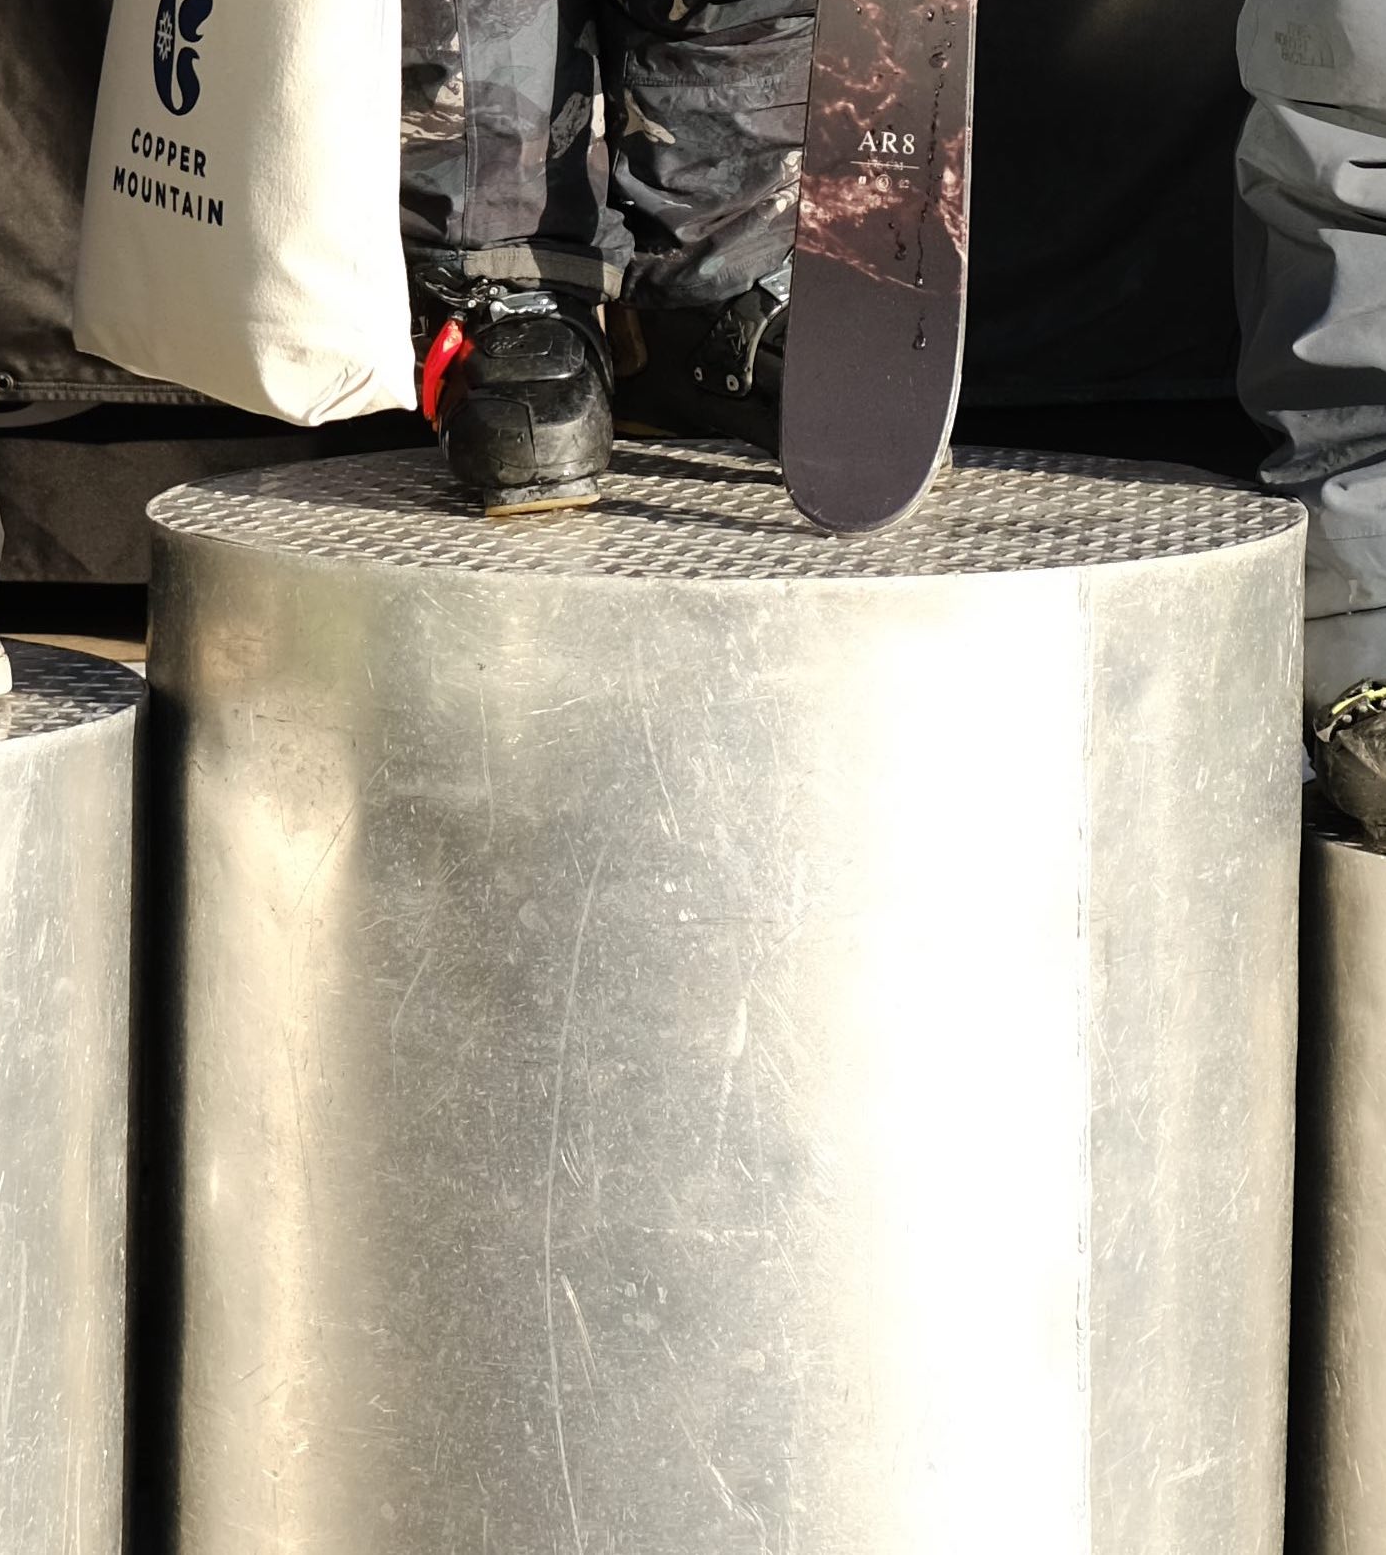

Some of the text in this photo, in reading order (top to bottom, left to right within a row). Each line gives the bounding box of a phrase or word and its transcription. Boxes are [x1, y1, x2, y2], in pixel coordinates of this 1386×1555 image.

[131, 126, 208, 179] COPPER
[856, 129, 916, 156] AR8
[113, 165, 225, 227] MOUNTAIN
